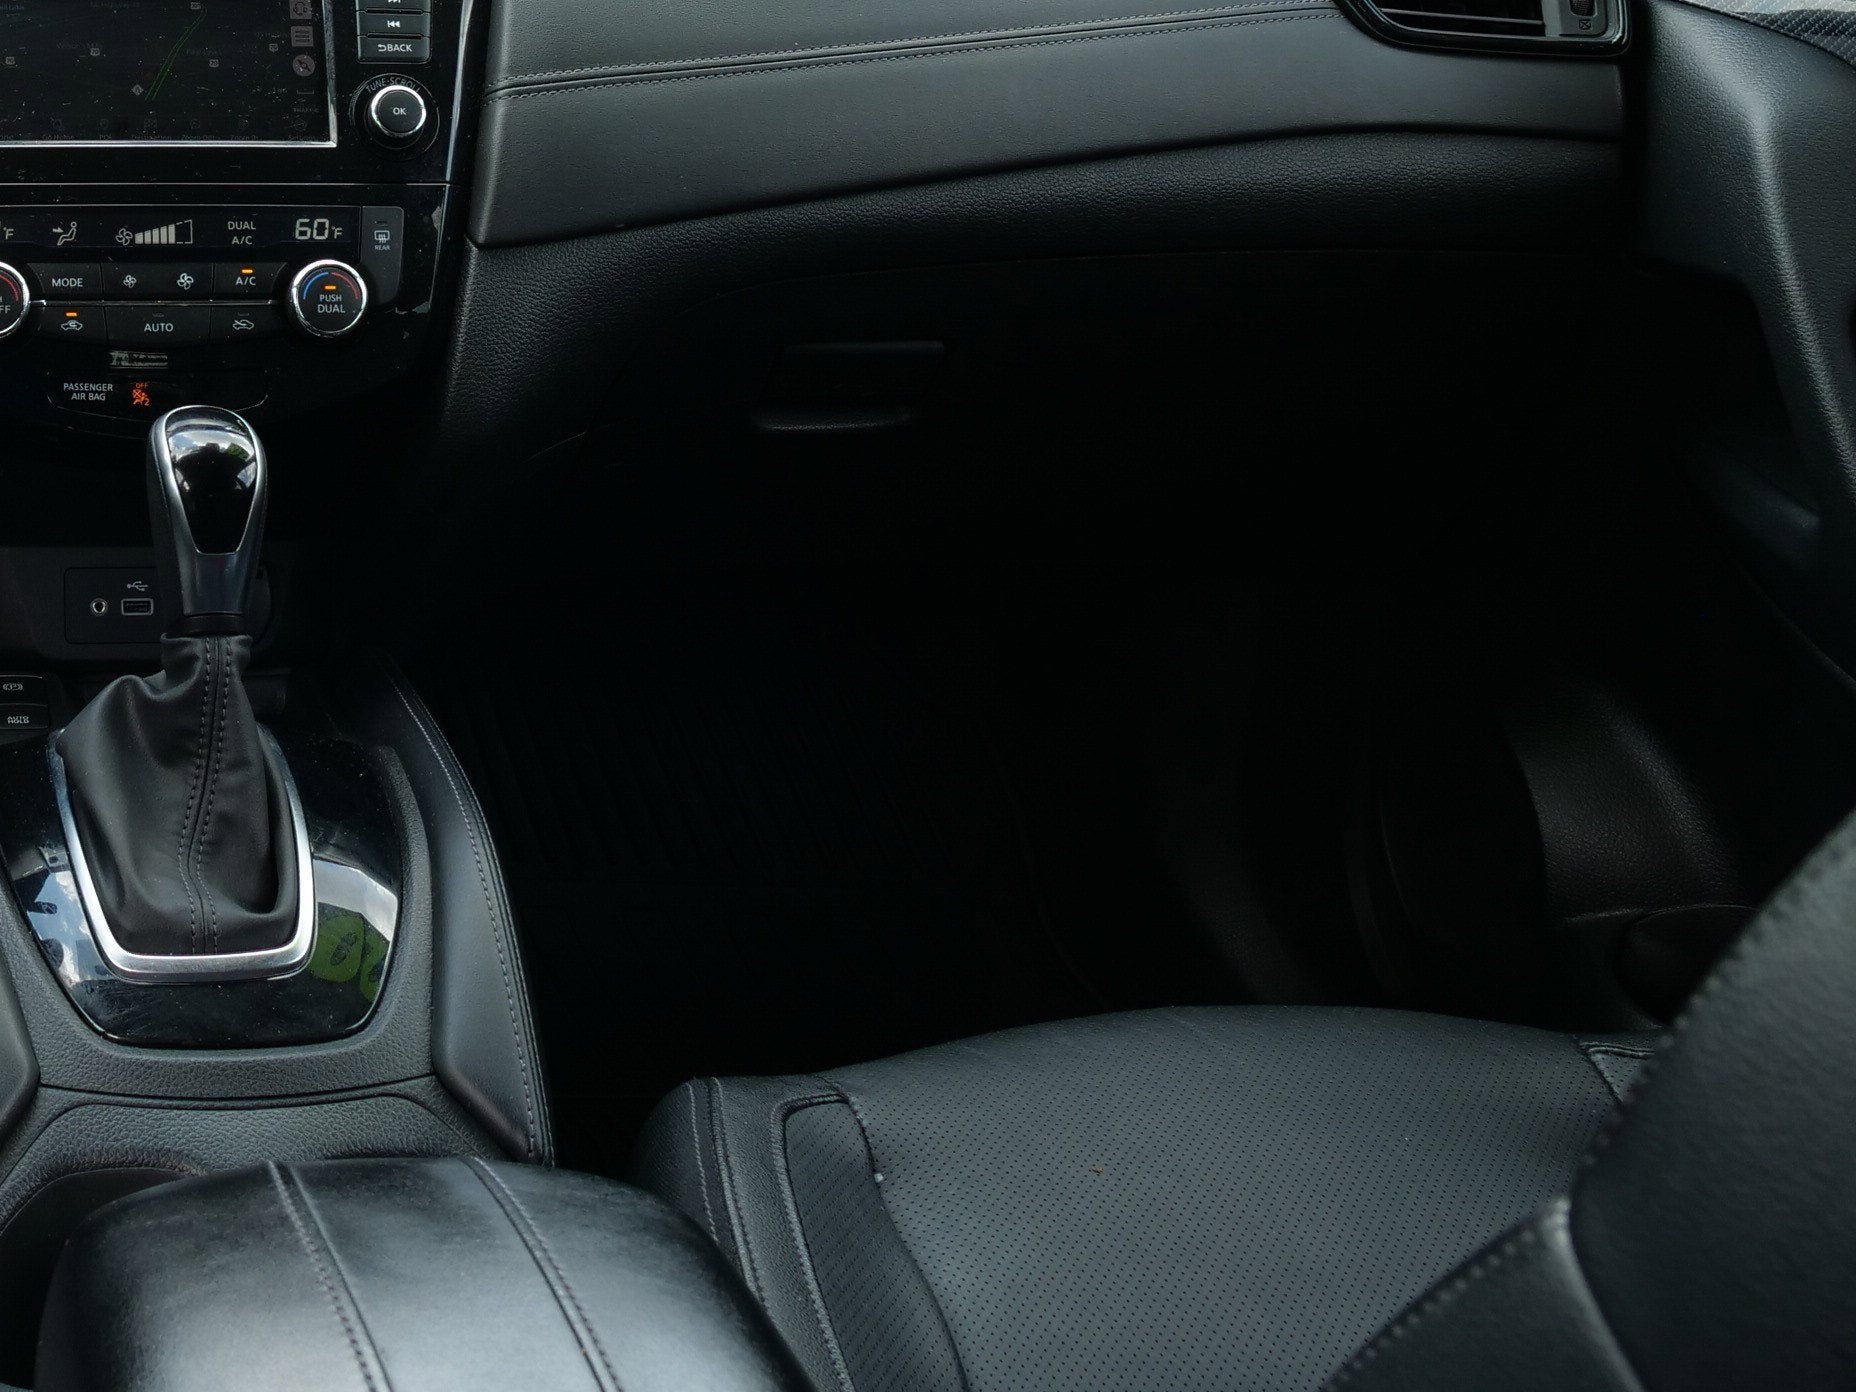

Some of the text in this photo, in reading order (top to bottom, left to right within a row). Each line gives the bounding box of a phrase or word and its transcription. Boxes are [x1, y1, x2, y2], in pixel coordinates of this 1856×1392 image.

[387, 44, 412, 52] BACK
[392, 107, 407, 116] OK
[227, 220, 256, 231] DUAL
[231, 235, 253, 245] A/C
[51, 278, 84, 288] MODE
[235, 276, 257, 286] A/C
[319, 294, 342, 302] PUSH
[317, 304, 345, 314] DUAL
[144, 323, 174, 332] AUTO
[63, 383, 114, 392] PASSENGER
[71, 392, 106, 401] AIR BAG
